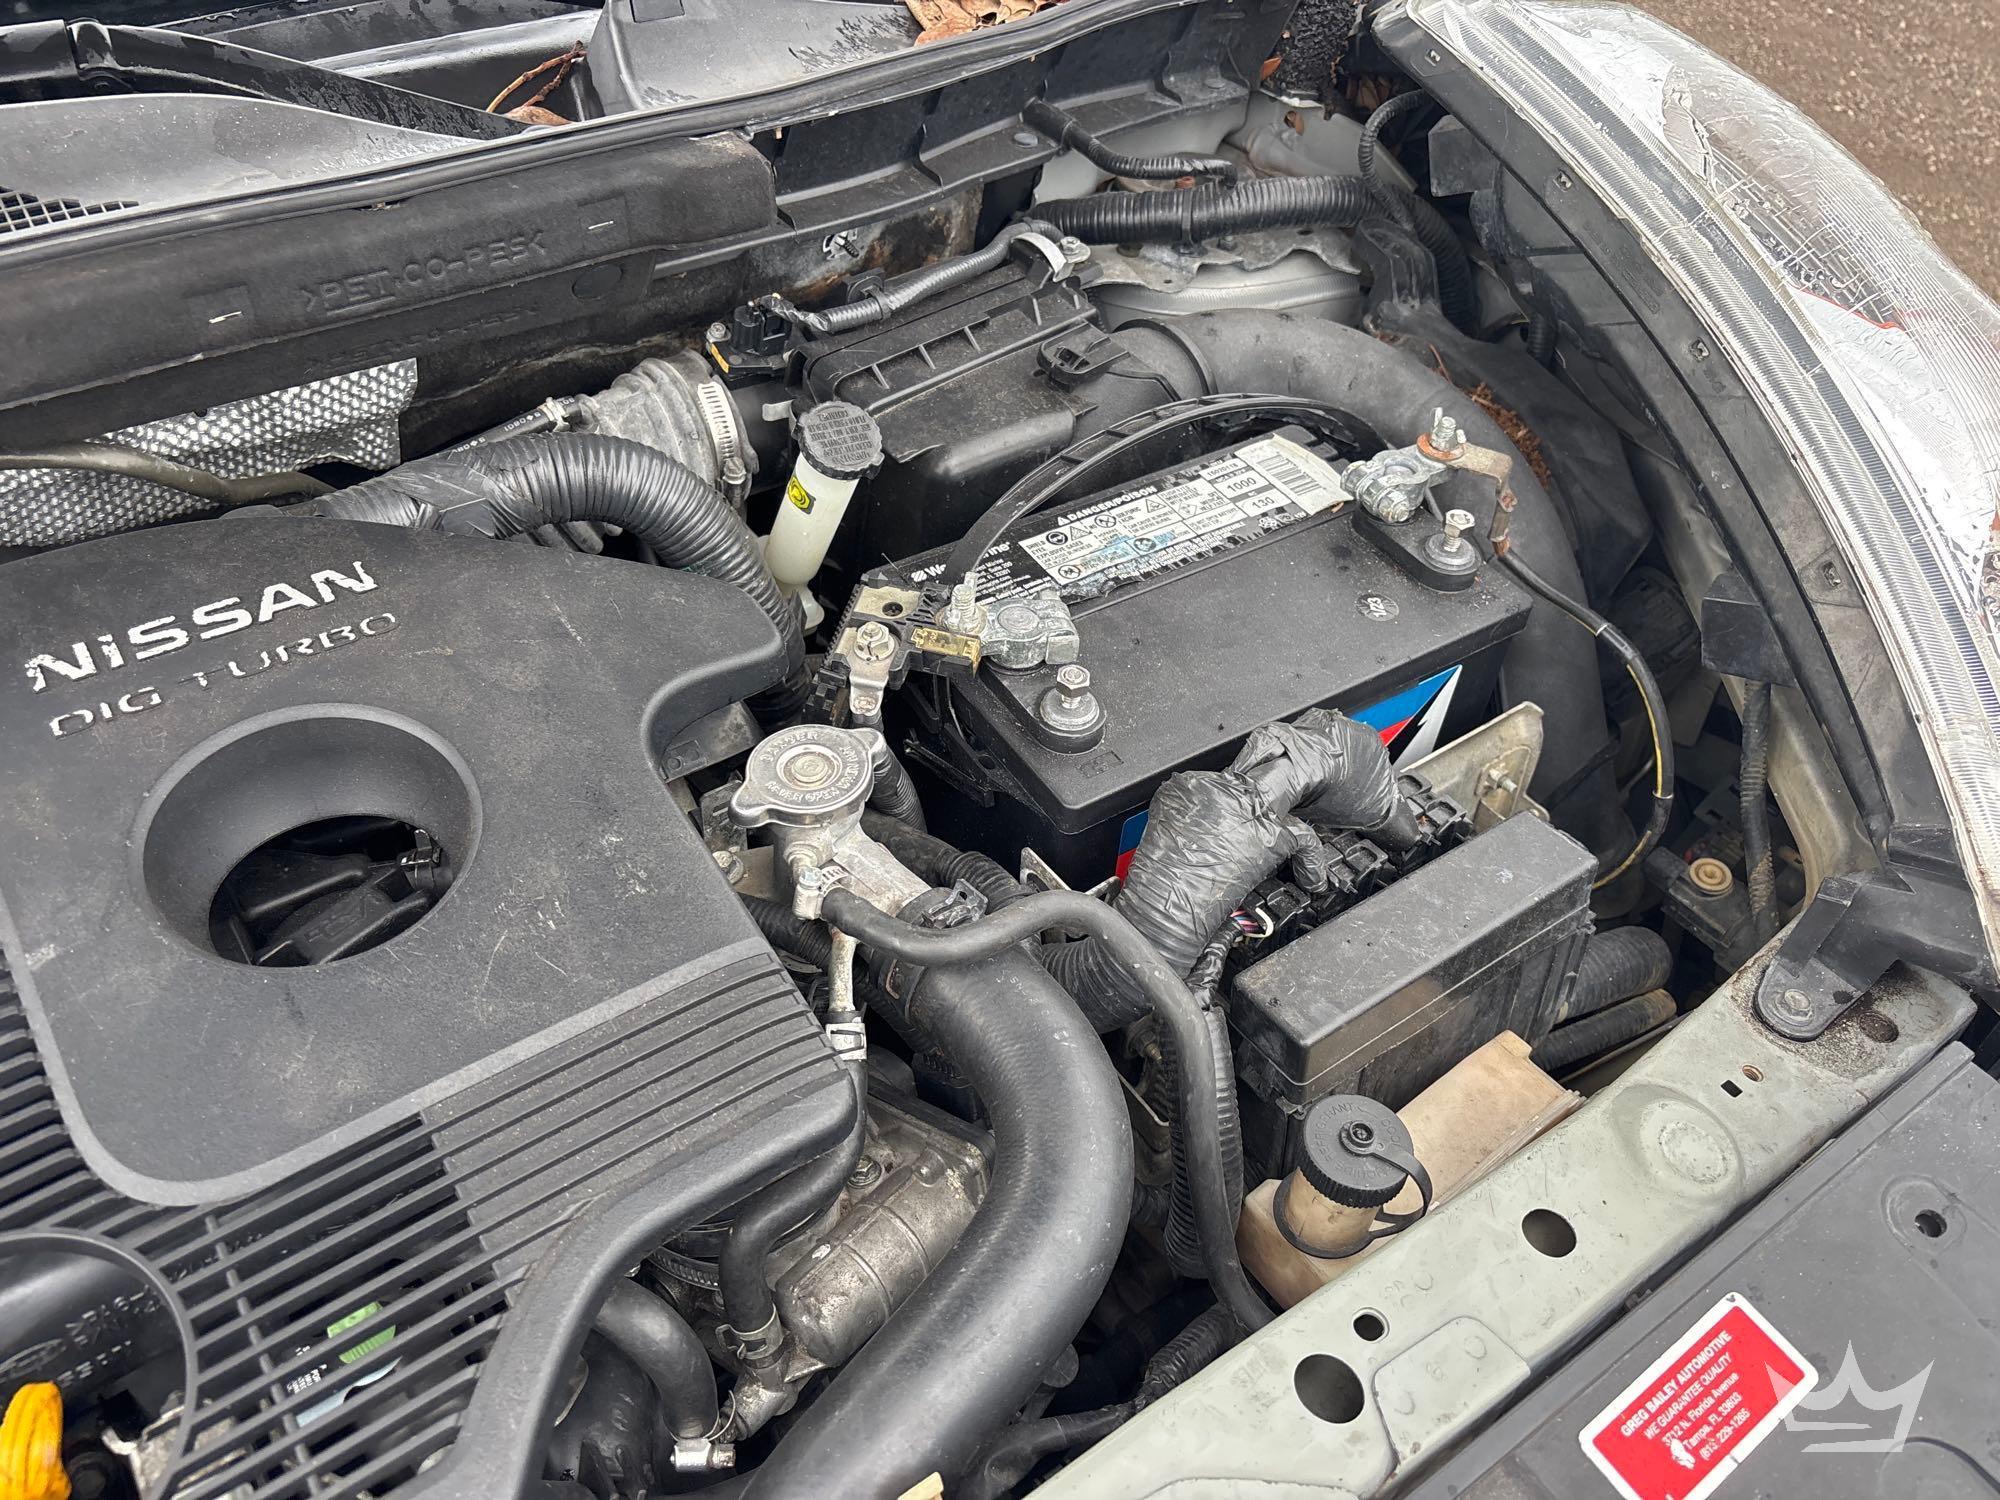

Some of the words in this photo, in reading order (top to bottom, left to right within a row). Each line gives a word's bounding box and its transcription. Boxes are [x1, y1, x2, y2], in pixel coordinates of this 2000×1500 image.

[1066, 485, 1158, 521] DANGER/POISON
[1226, 476, 1256, 492] 1000
[1251, 496, 1274, 508] 130
[1036, 547, 1066, 559] EXPLOSIVE
[25, 561, 379, 693] NISSAN
[49, 687, 163, 739] DIG
[177, 612, 402, 691] TURBO
[1619, 1408, 1650, 1437] GREG
[1645, 1380, 1680, 1413] BAILEY
[1675, 1330, 1732, 1385] AUTOMOTIVE
[1644, 1423, 1660, 1439] WE
[1656, 1381, 1704, 1427] GUARANTEE
[1700, 1352, 1733, 1385] QUALITY
[1688, 1394, 1715, 1421] Florida
[1712, 1372, 1739, 1398] Avenue
[1683, 1421, 1713, 1451] Tampa,
